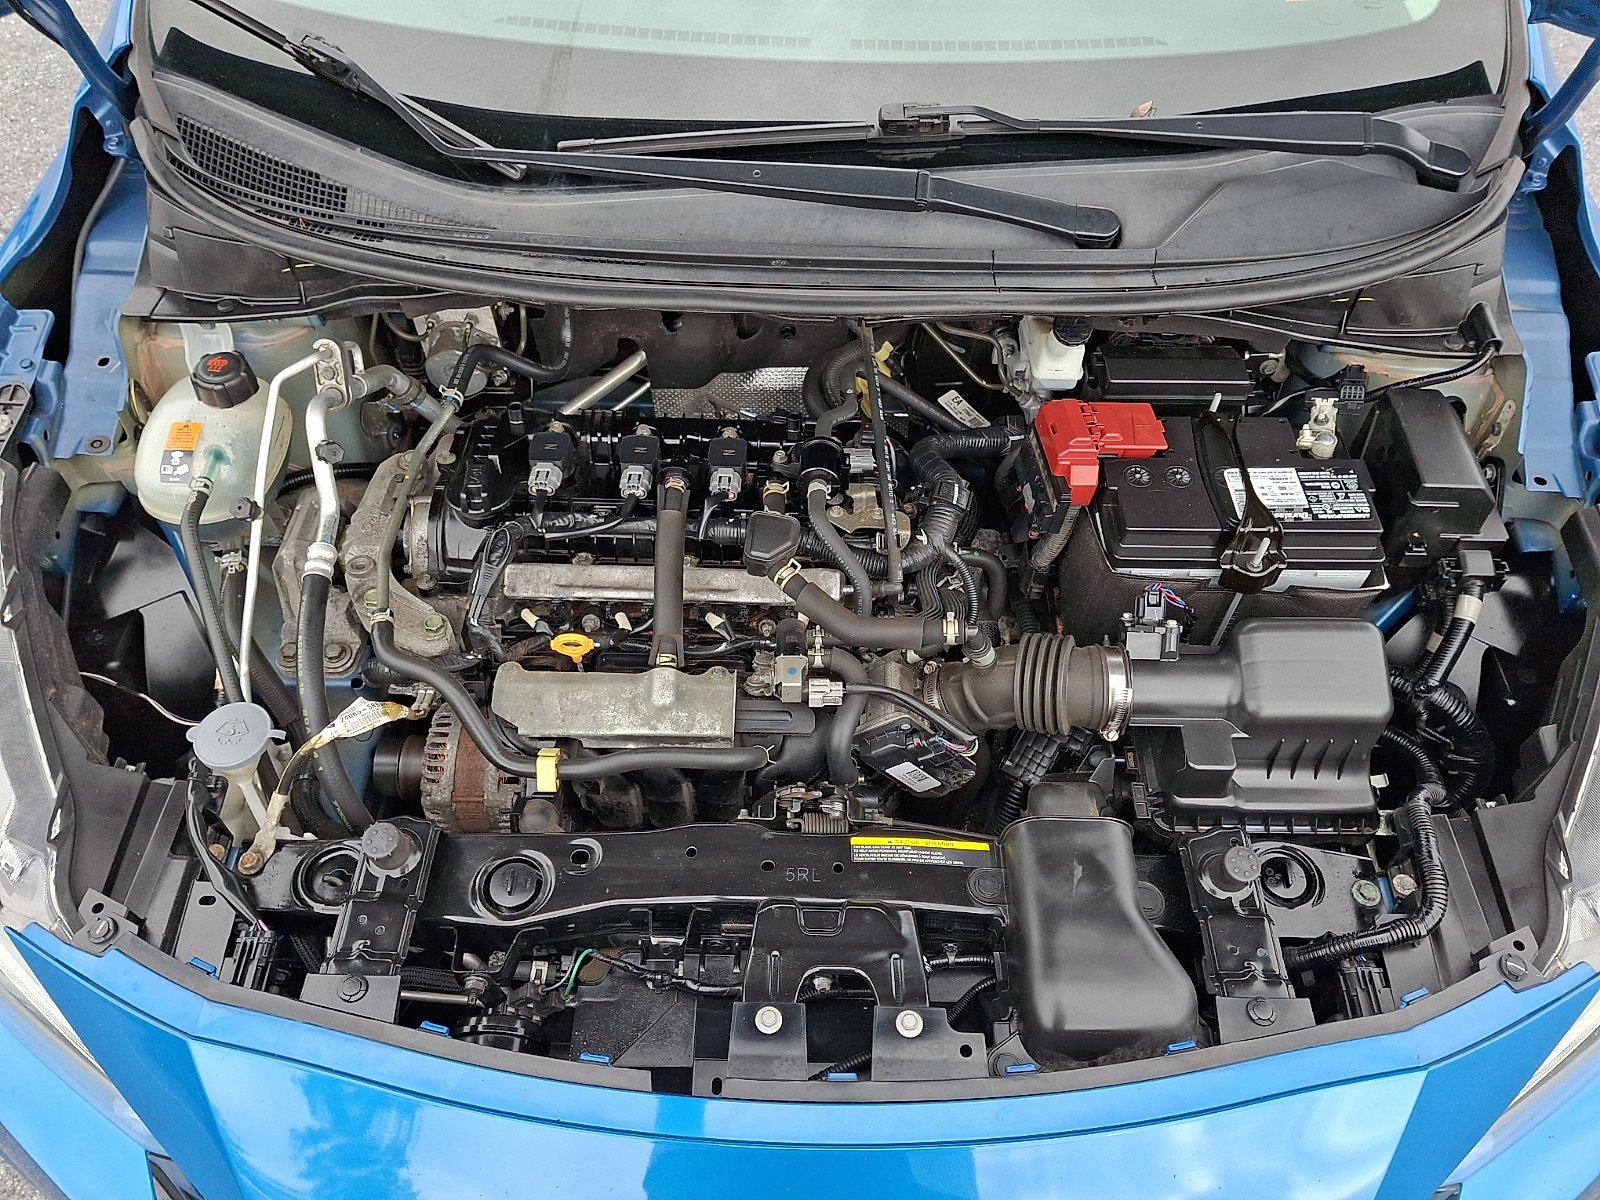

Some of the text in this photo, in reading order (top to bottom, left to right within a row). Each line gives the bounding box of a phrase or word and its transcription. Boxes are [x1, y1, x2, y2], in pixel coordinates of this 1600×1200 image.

[951, 395, 963, 406] EA
[1271, 510, 1309, 520] Duralas
[785, 867, 821, 882] 5RL
